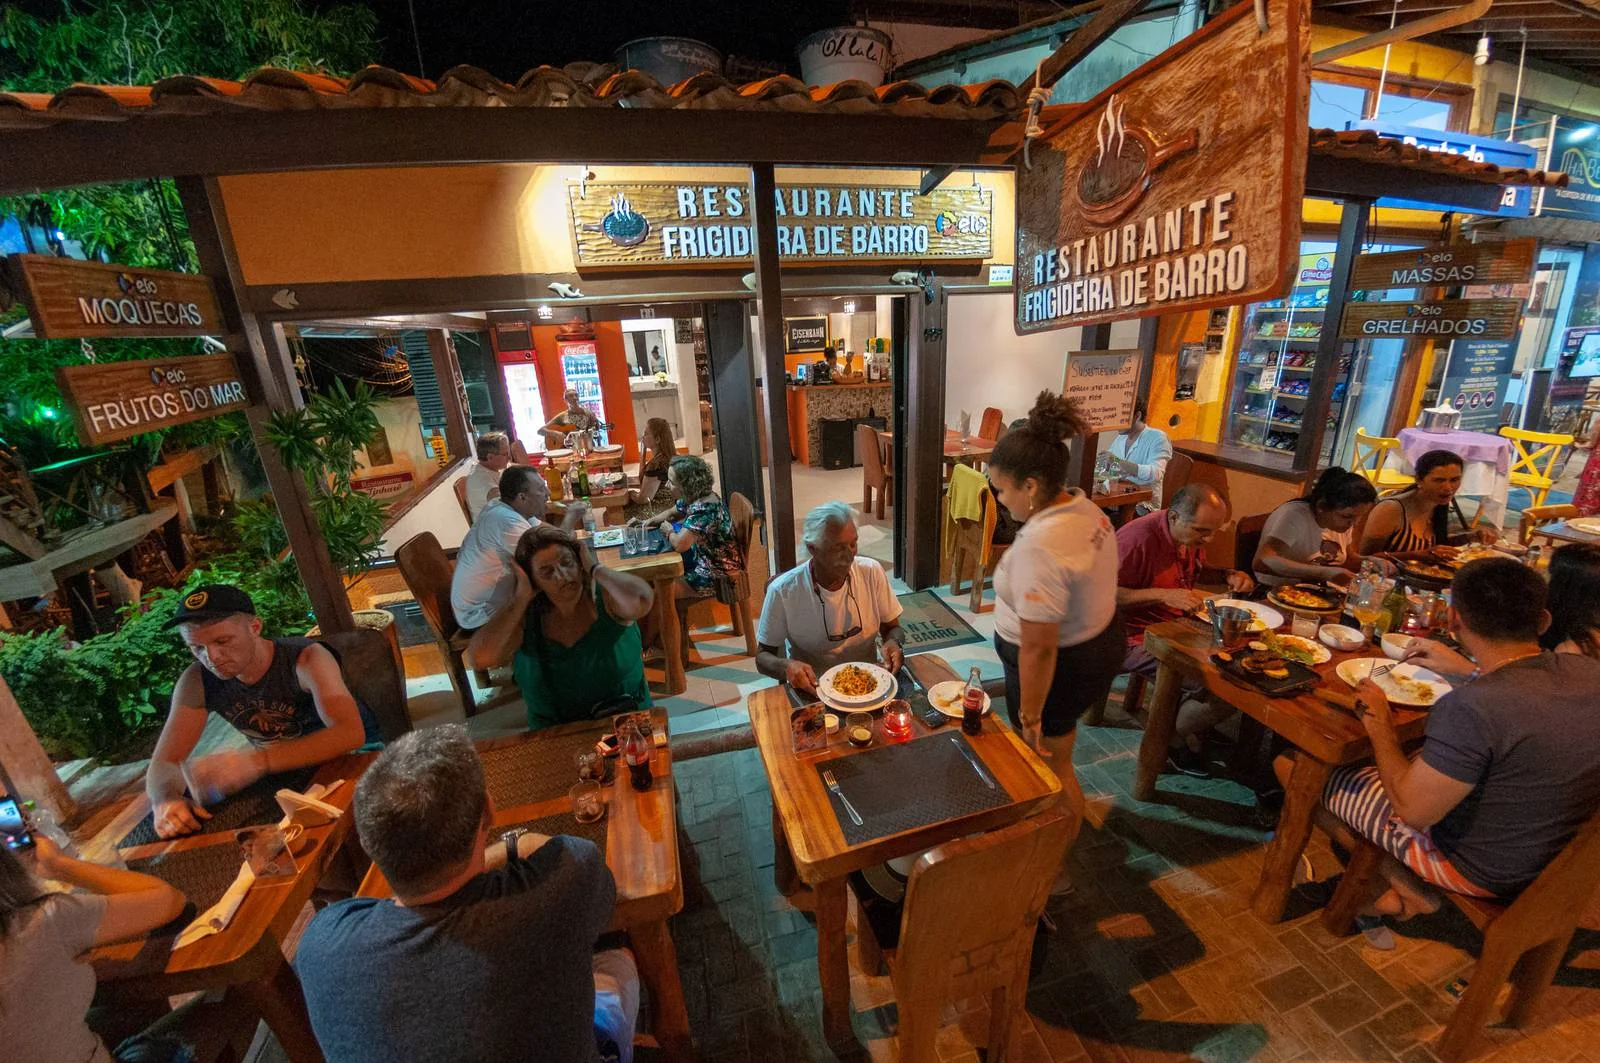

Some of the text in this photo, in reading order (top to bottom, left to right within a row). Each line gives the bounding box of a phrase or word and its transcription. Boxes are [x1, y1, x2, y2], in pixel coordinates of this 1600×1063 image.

[677, 186, 914, 218] RESAURANTE
[663, 224, 928, 258] FRIGIDRA DE BARRO
[1034, 192, 1234, 285] RESTAURANTE
[1024, 244, 1248, 322] FRIGIDEIRA DE BARRO
[1392, 265, 1475, 284] MASSAS
[77, 297, 202, 326] MOQUECAS
[1362, 319, 1486, 334] GRELHADOS
[87, 381, 246, 432] FRUTOS DO MAR
[911, 628, 957, 642] BARRO
